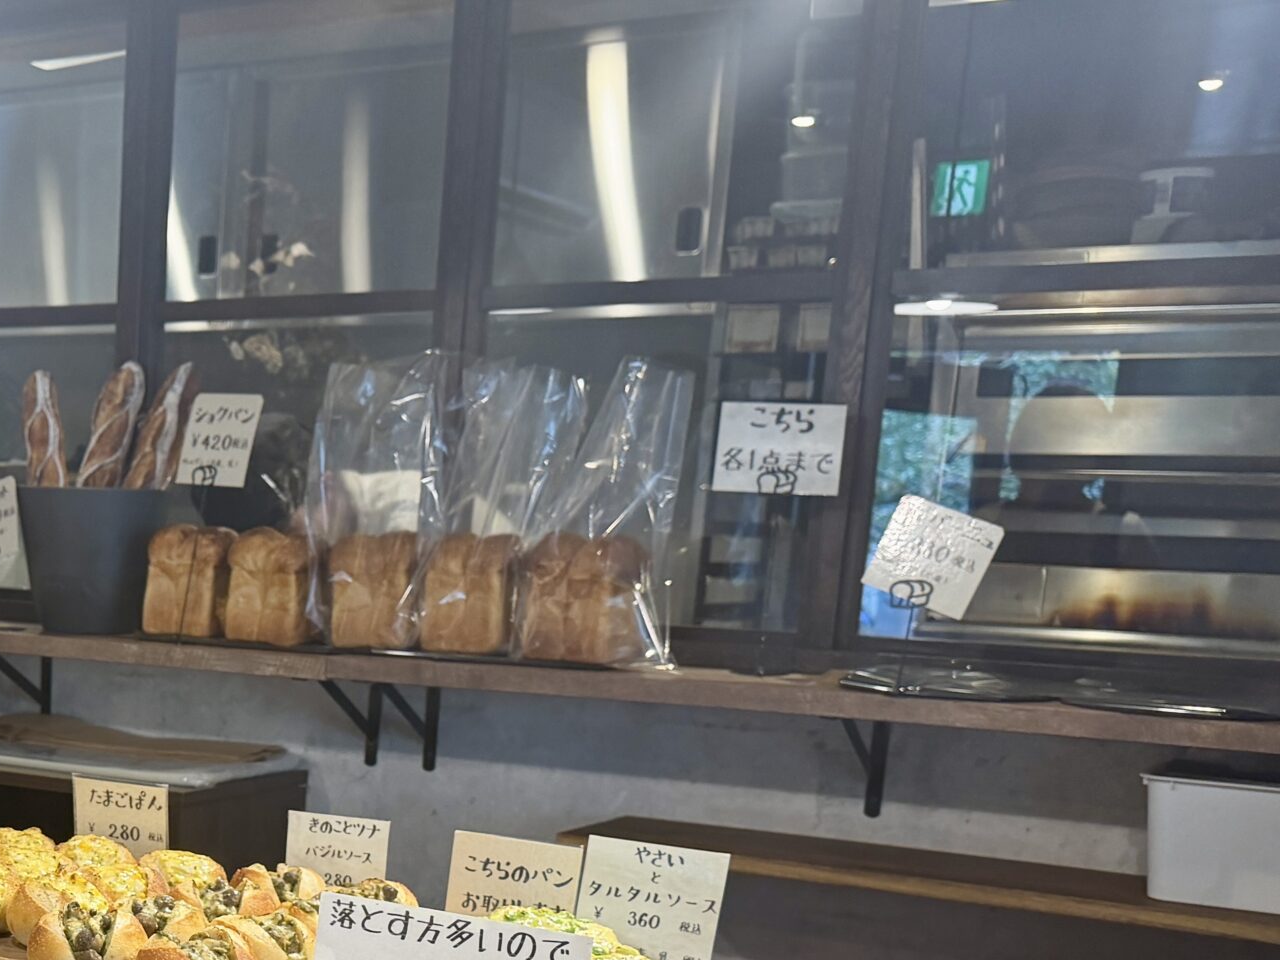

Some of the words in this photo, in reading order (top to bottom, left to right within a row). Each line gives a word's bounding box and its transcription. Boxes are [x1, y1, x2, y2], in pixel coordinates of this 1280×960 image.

[750, 407, 814, 433] こちら
[721, 448, 833, 474] 各1点まで
[89, 789, 162, 810] たまごぱん
[109, 823, 140, 841] 280
[309, 818, 381, 839] きのことツナ
[305, 845, 372, 864] バジルソース
[635, 846, 685, 867] やさい
[465, 855, 573, 887] こちらのパン
[651, 872, 661, 884] と
[589, 880, 717, 914] タルタルソース
[594, 906, 604, 918] ¥
[627, 911, 661, 929] 360
[679, 921, 701, 935] 税込
